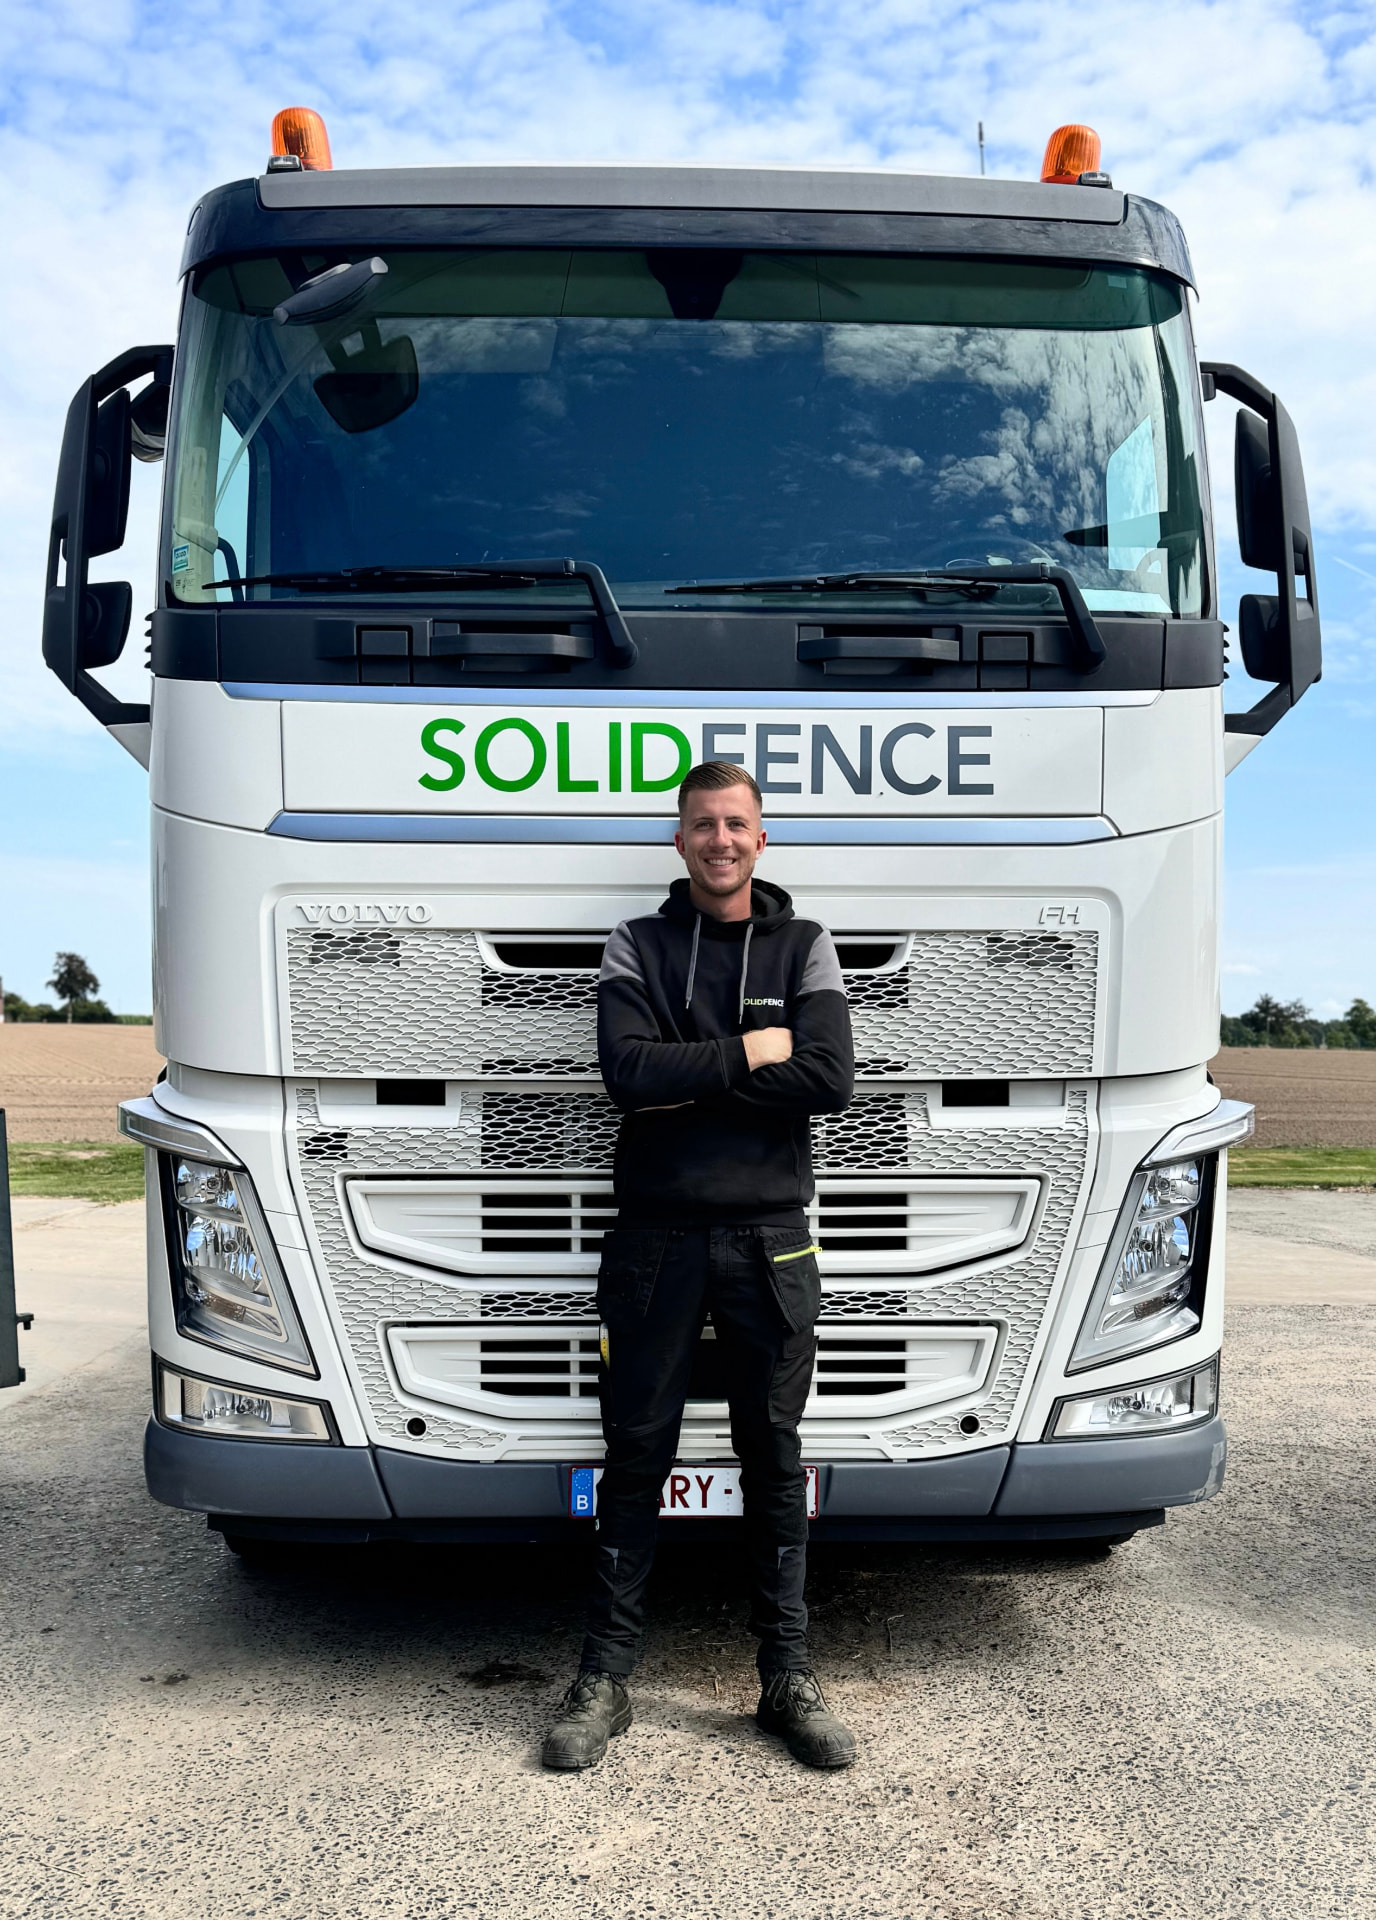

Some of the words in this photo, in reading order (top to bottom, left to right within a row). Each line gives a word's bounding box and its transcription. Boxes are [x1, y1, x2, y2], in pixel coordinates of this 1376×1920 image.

[296, 903, 433, 923] VOLVO
[1038, 905, 1083, 924] FH
[743, 998, 785, 1007] OLIDFENCE
[576, 1494, 589, 1511] B
